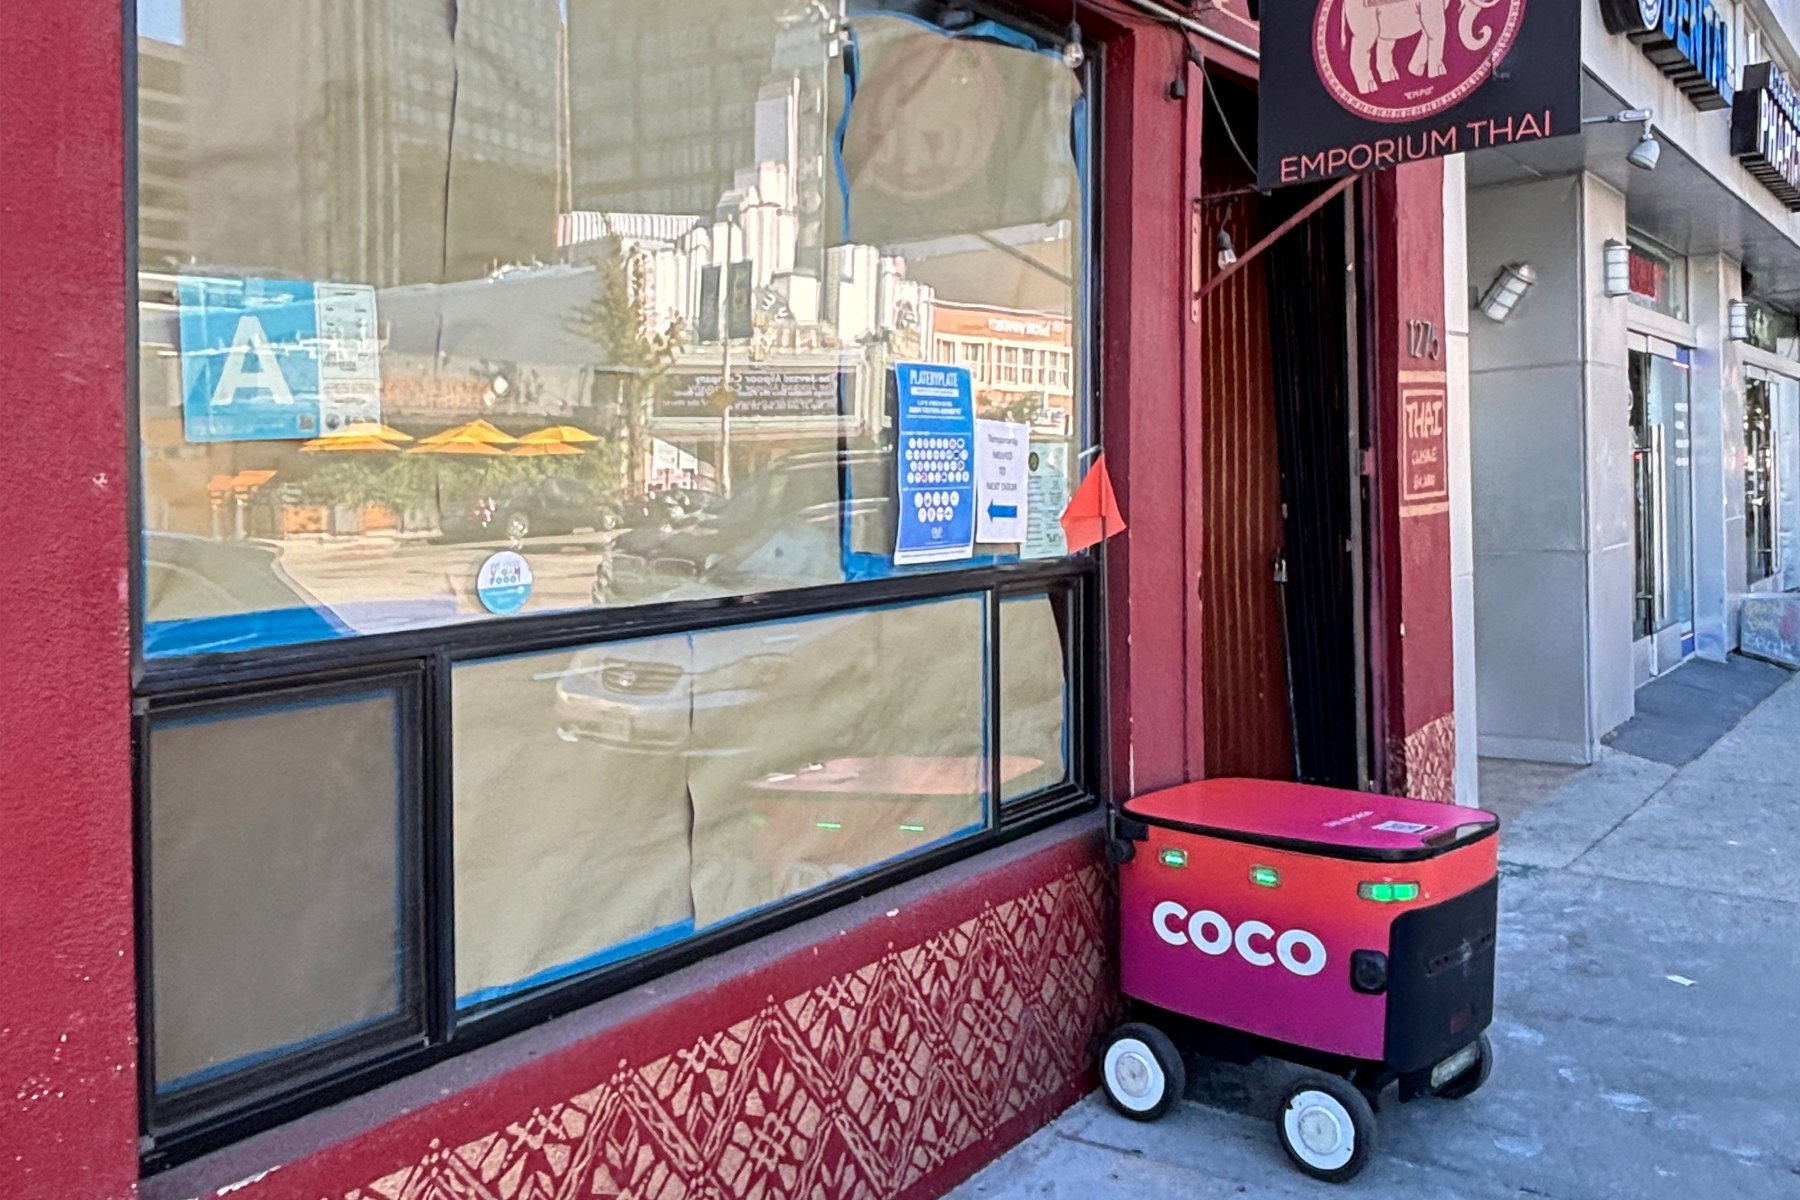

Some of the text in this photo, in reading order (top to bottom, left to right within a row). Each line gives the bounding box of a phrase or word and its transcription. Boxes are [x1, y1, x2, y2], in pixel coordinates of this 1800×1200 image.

[1280, 110, 1552, 182] EMPORIUM THAI
[209, 315, 295, 406] A
[1406, 401, 1443, 439] THAI
